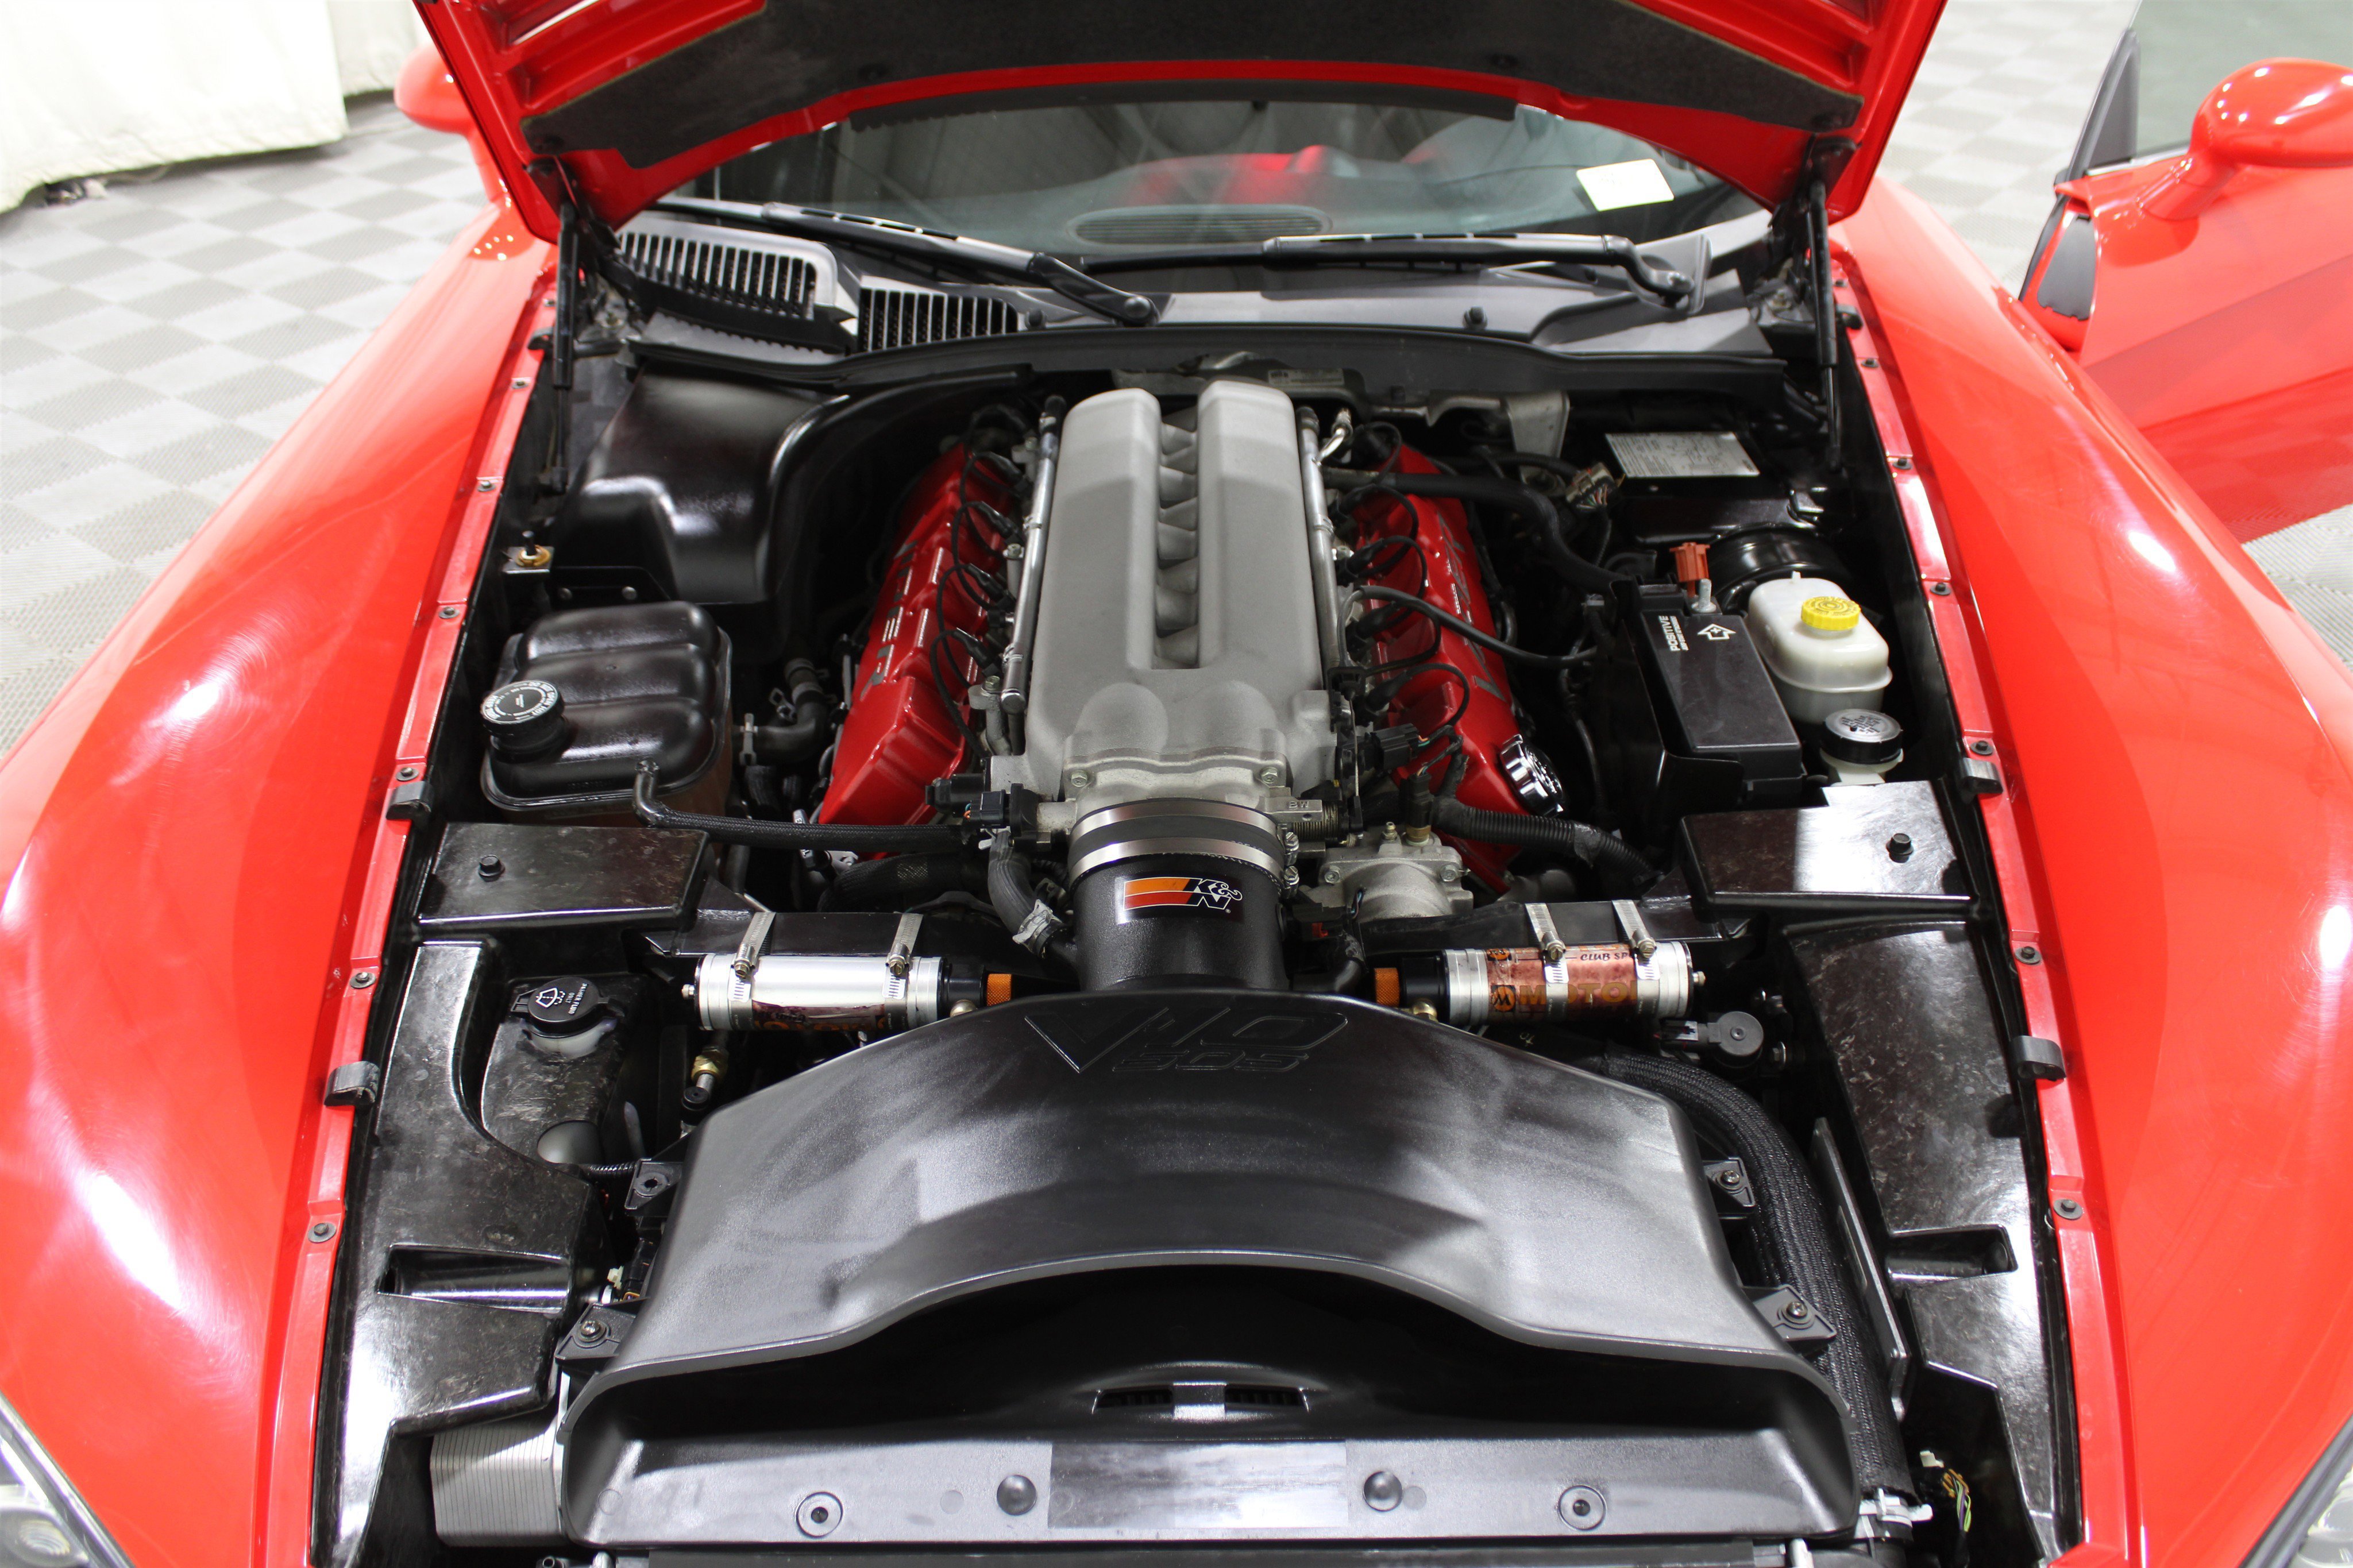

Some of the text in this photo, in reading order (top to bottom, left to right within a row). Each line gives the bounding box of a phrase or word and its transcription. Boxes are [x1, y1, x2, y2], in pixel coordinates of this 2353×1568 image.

[1658, 615, 1681, 651] POSITIVE
[1580, 952, 1611, 961] CLUB
[565, 992, 575, 1004] ONLY
[568, 1001, 580, 1014] FLUID
